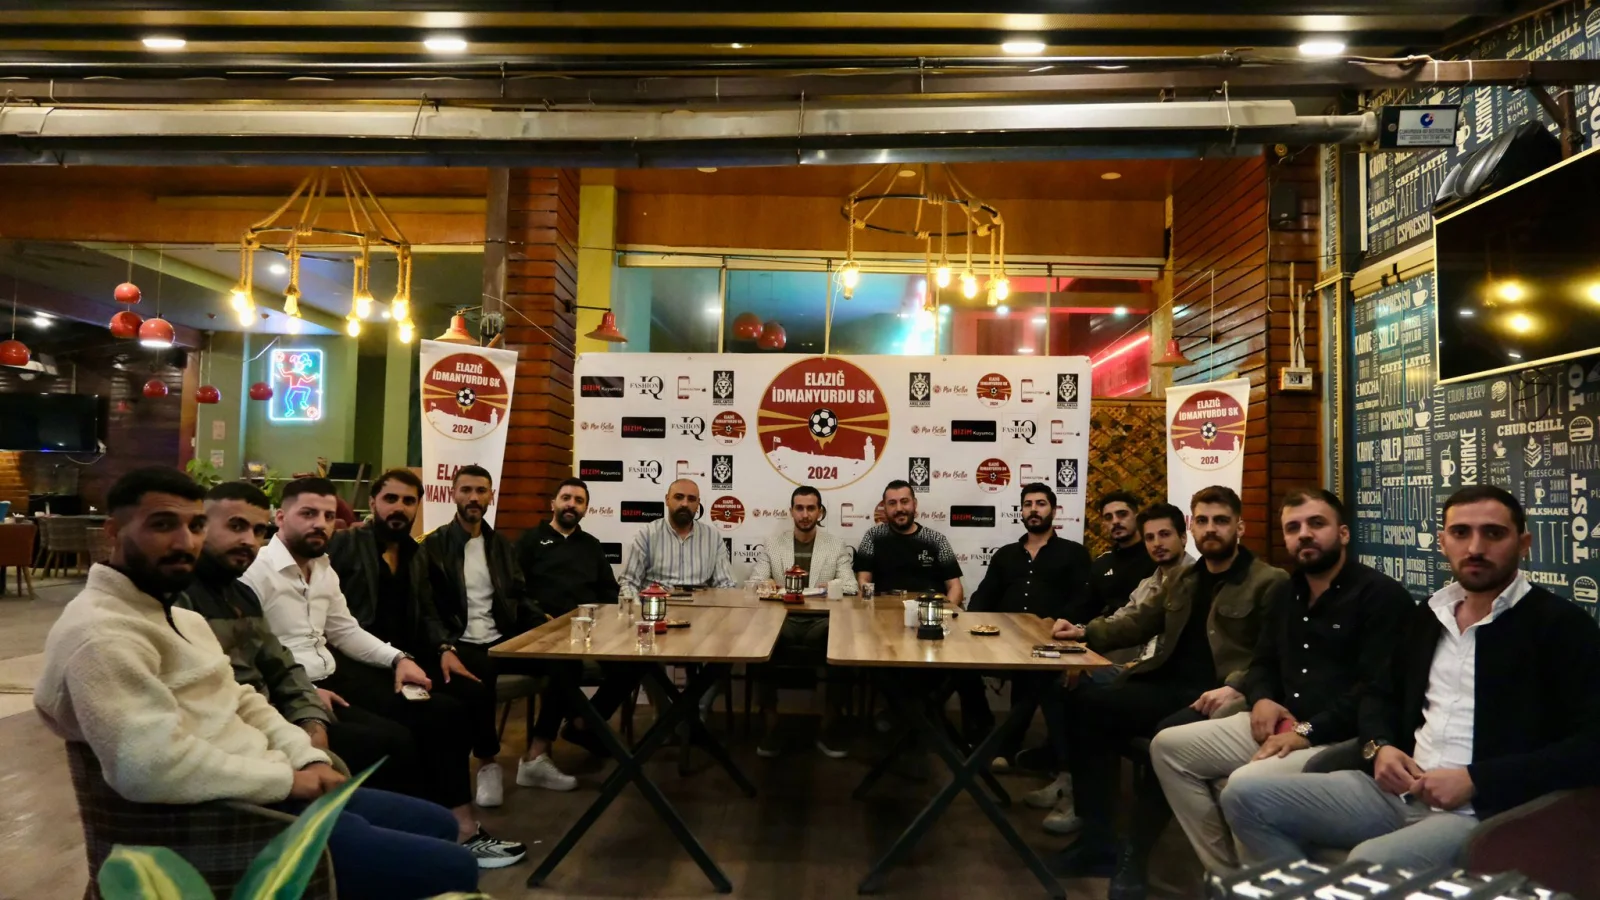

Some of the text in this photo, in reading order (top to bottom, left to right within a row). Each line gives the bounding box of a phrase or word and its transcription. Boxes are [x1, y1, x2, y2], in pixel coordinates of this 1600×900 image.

[1420, 150, 1448, 175] LATTE
[1374, 195, 1396, 218] MOCHA
[1396, 211, 1431, 245] ESPRESSO
[456, 362, 483, 374] ELAZIĞ
[1405, 353, 1431, 368] LATTE
[432, 369, 501, 388] İDMANYURDU SK
[805, 370, 845, 387] ELAZIĞ
[772, 386, 875, 404] İDMANYURDU SK
[1359, 379, 1379, 397] MOCHA
[1197, 397, 1221, 410] ELAZIĞ
[1433, 384, 1446, 429] FROZEN
[1178, 406, 1239, 421] İDMANYURDU SK
[1381, 407, 1413, 431] ESPRESSO
[1490, 409, 1507, 419] SUFLE
[452, 424, 474, 435] 2024
[1497, 418, 1565, 437] CHURCHILL
[1356, 440, 1375, 462] KAHVE
[1381, 437, 1402, 462] SALEP
[1552, 441, 1568, 456] PASTA
[1201, 456, 1219, 465] 2024
[807, 466, 838, 480] 2024
[1490, 466, 1511, 474] MINT
[1524, 468, 1565, 479] CHEESECAKE
[1407, 475, 1434, 486] LATTE
[1361, 491, 1381, 505] MOCHA
[1525, 507, 1569, 516] MILKSHAKE
[1570, 473, 1589, 564] TOST
[1383, 525, 1416, 546] ESPRESSO
[1522, 521, 1569, 565] ATTE
[970, 553, 993, 561] FASHI
